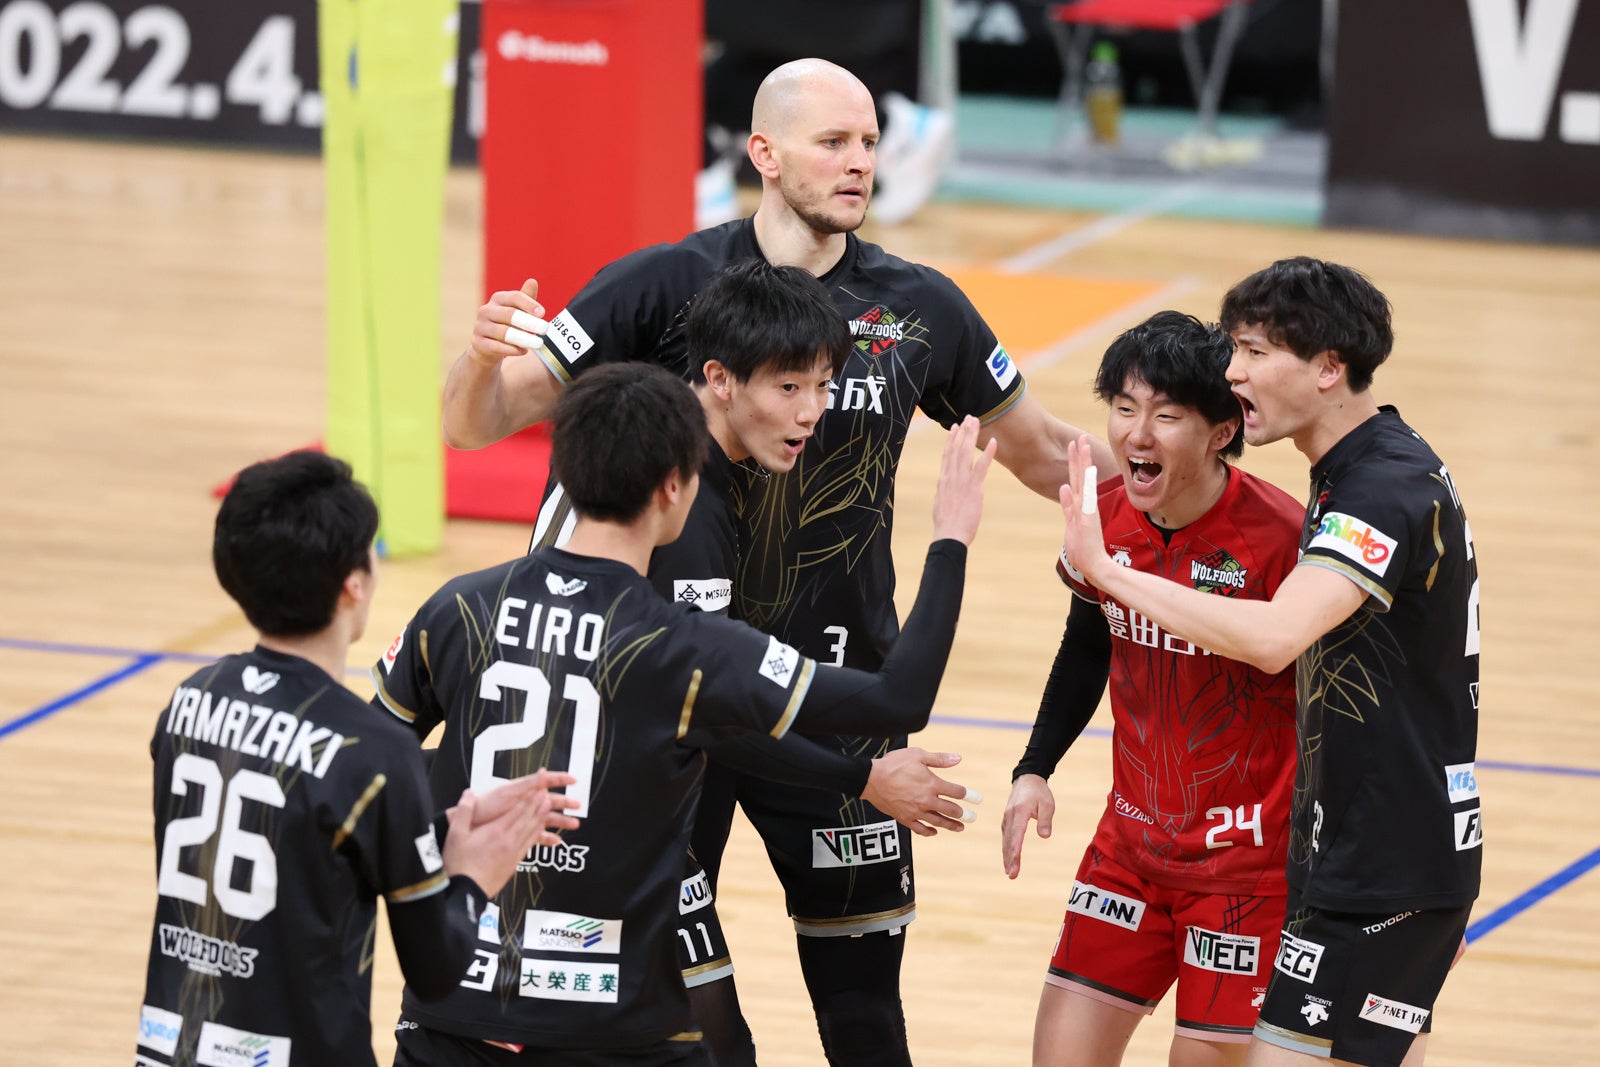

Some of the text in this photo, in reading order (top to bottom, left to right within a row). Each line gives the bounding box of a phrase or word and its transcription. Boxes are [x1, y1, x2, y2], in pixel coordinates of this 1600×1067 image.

[848, 319, 905, 341] WOLFDOGS
[1190, 559, 1249, 590] WOLFDOGS
[495, 596, 606, 662] EIRO
[819, 625, 849, 668] 3
[165, 685, 345, 779] YAMAZAKI
[469, 660, 602, 820] 21
[157, 752, 287, 921] 26
[1205, 803, 1264, 850] 24
[539, 928, 583, 939] MATSUO
[677, 922, 714, 963] 11
[1362, 910, 1413, 935] TOYODA
[158, 922, 260, 979] WOLFDOGS
[1304, 993, 1334, 1008] DESCENTE
